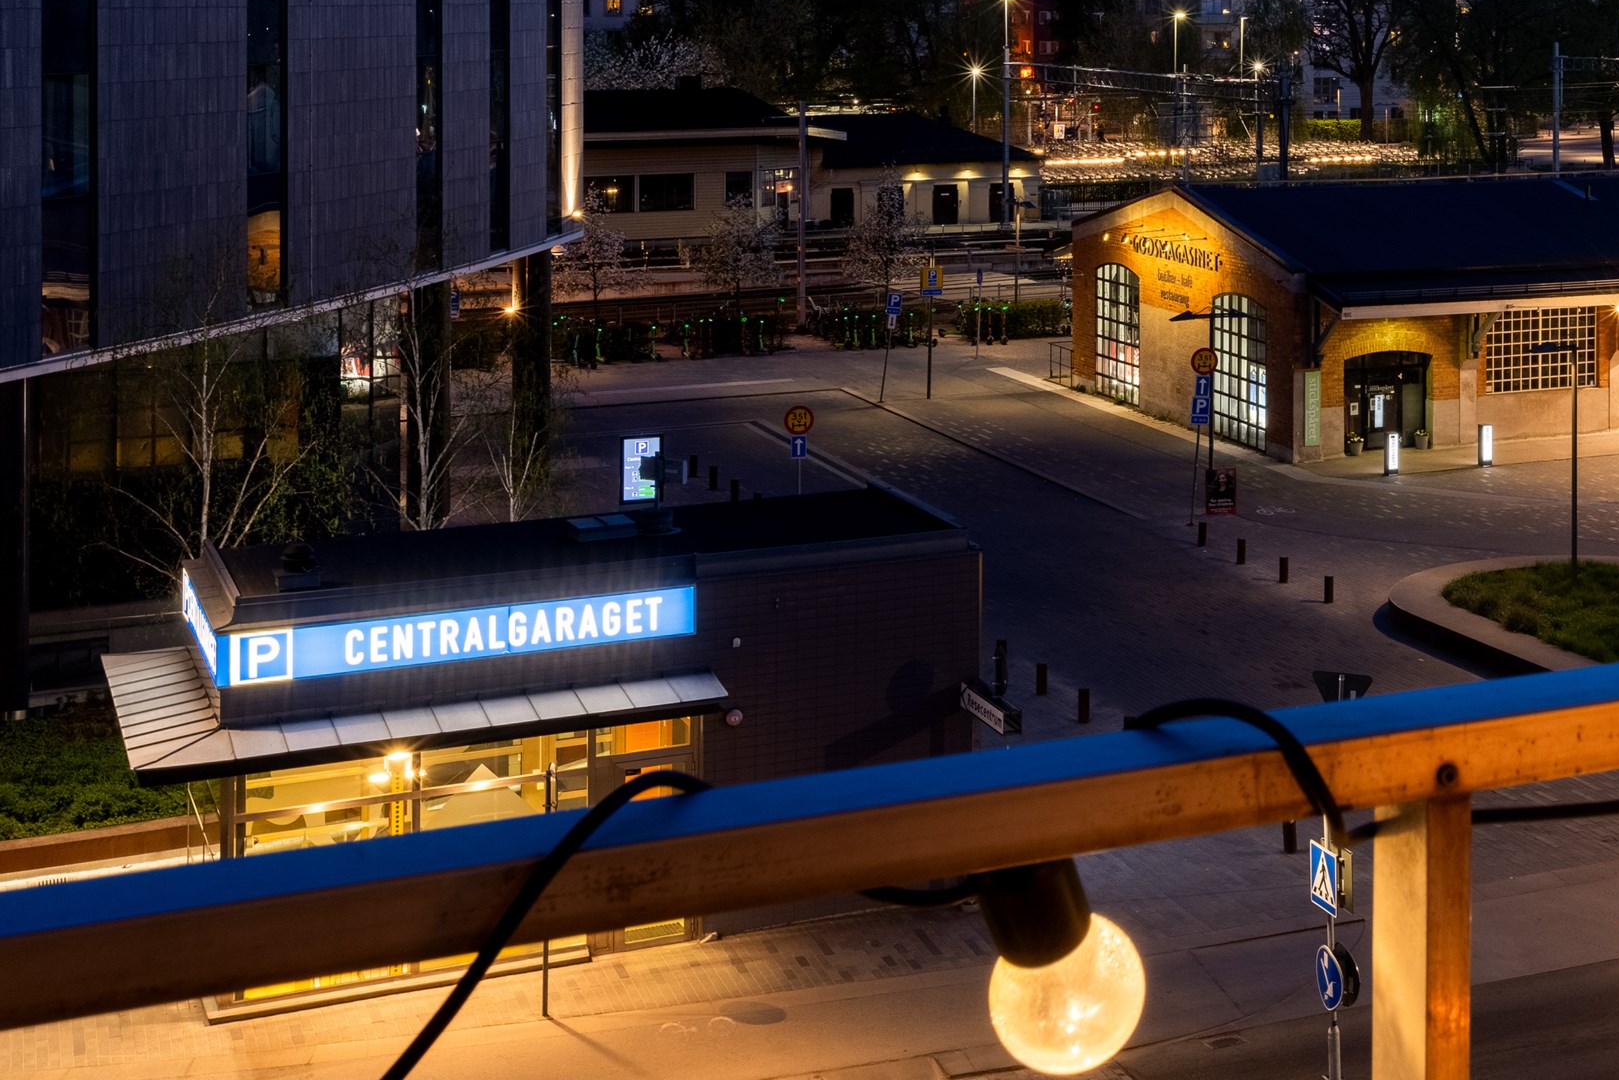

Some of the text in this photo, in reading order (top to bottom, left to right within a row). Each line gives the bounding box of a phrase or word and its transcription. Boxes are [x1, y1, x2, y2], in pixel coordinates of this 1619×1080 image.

[890, 295, 900, 306] P
[1196, 399, 1207, 413] P
[248, 596, 665, 679] P CENTRALGARAGET
[967, 693, 1002, 729] Resecentrum
